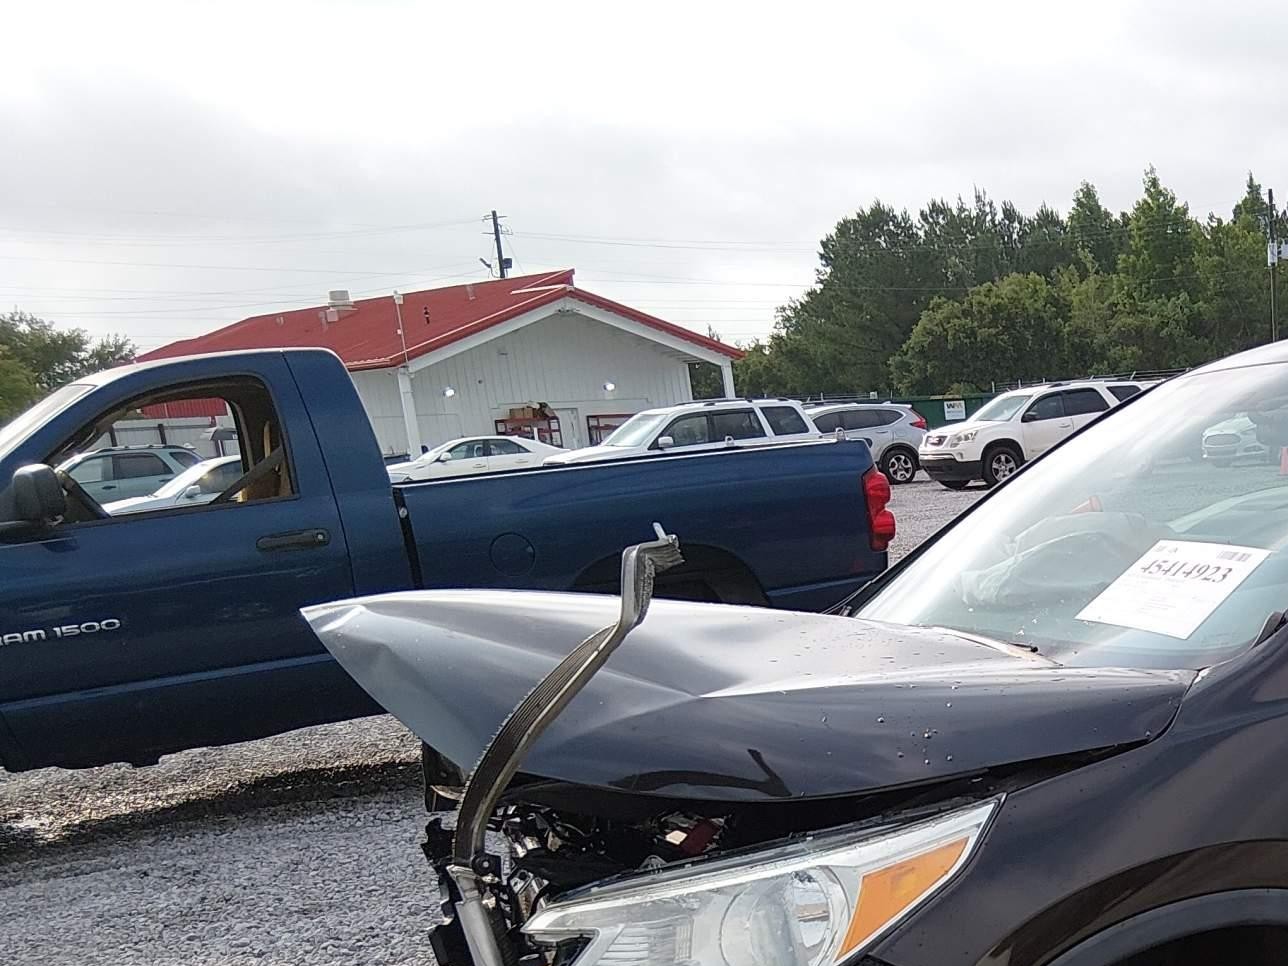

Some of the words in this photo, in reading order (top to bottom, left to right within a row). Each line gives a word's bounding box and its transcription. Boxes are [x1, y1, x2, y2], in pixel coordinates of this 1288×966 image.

[1140, 560, 1233, 583] 45414923
[0, 629, 46, 646] AM
[52, 618, 121, 638] 1500
